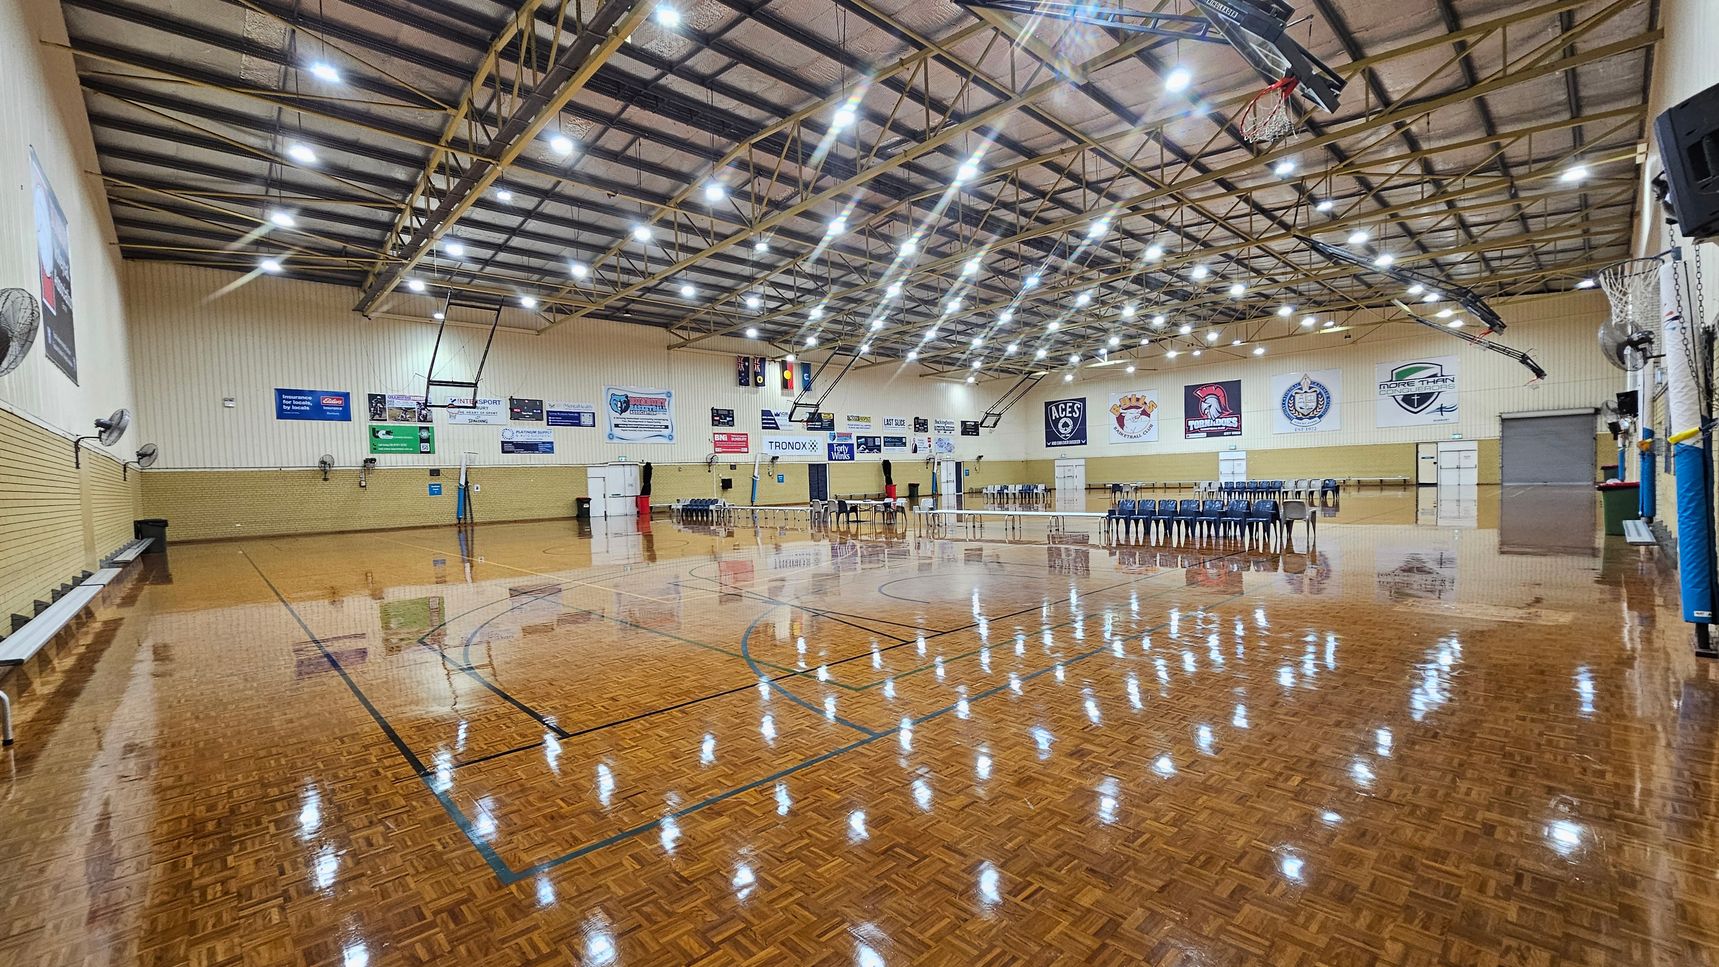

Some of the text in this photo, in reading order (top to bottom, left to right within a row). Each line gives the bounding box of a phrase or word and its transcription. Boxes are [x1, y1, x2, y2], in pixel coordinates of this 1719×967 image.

[1379, 377, 1455, 389] MORE THAN
[1379, 383, 1455, 395] CONQUERORS
[1051, 402, 1081, 420] ACES
[1188, 417, 1238, 430] TORNADOES
[1113, 423, 1154, 439] BASKETBALL CLUB
[768, 441, 808, 450] TRONOX
[833, 444, 849, 453] Forty
[831, 451, 851, 461] Winks
